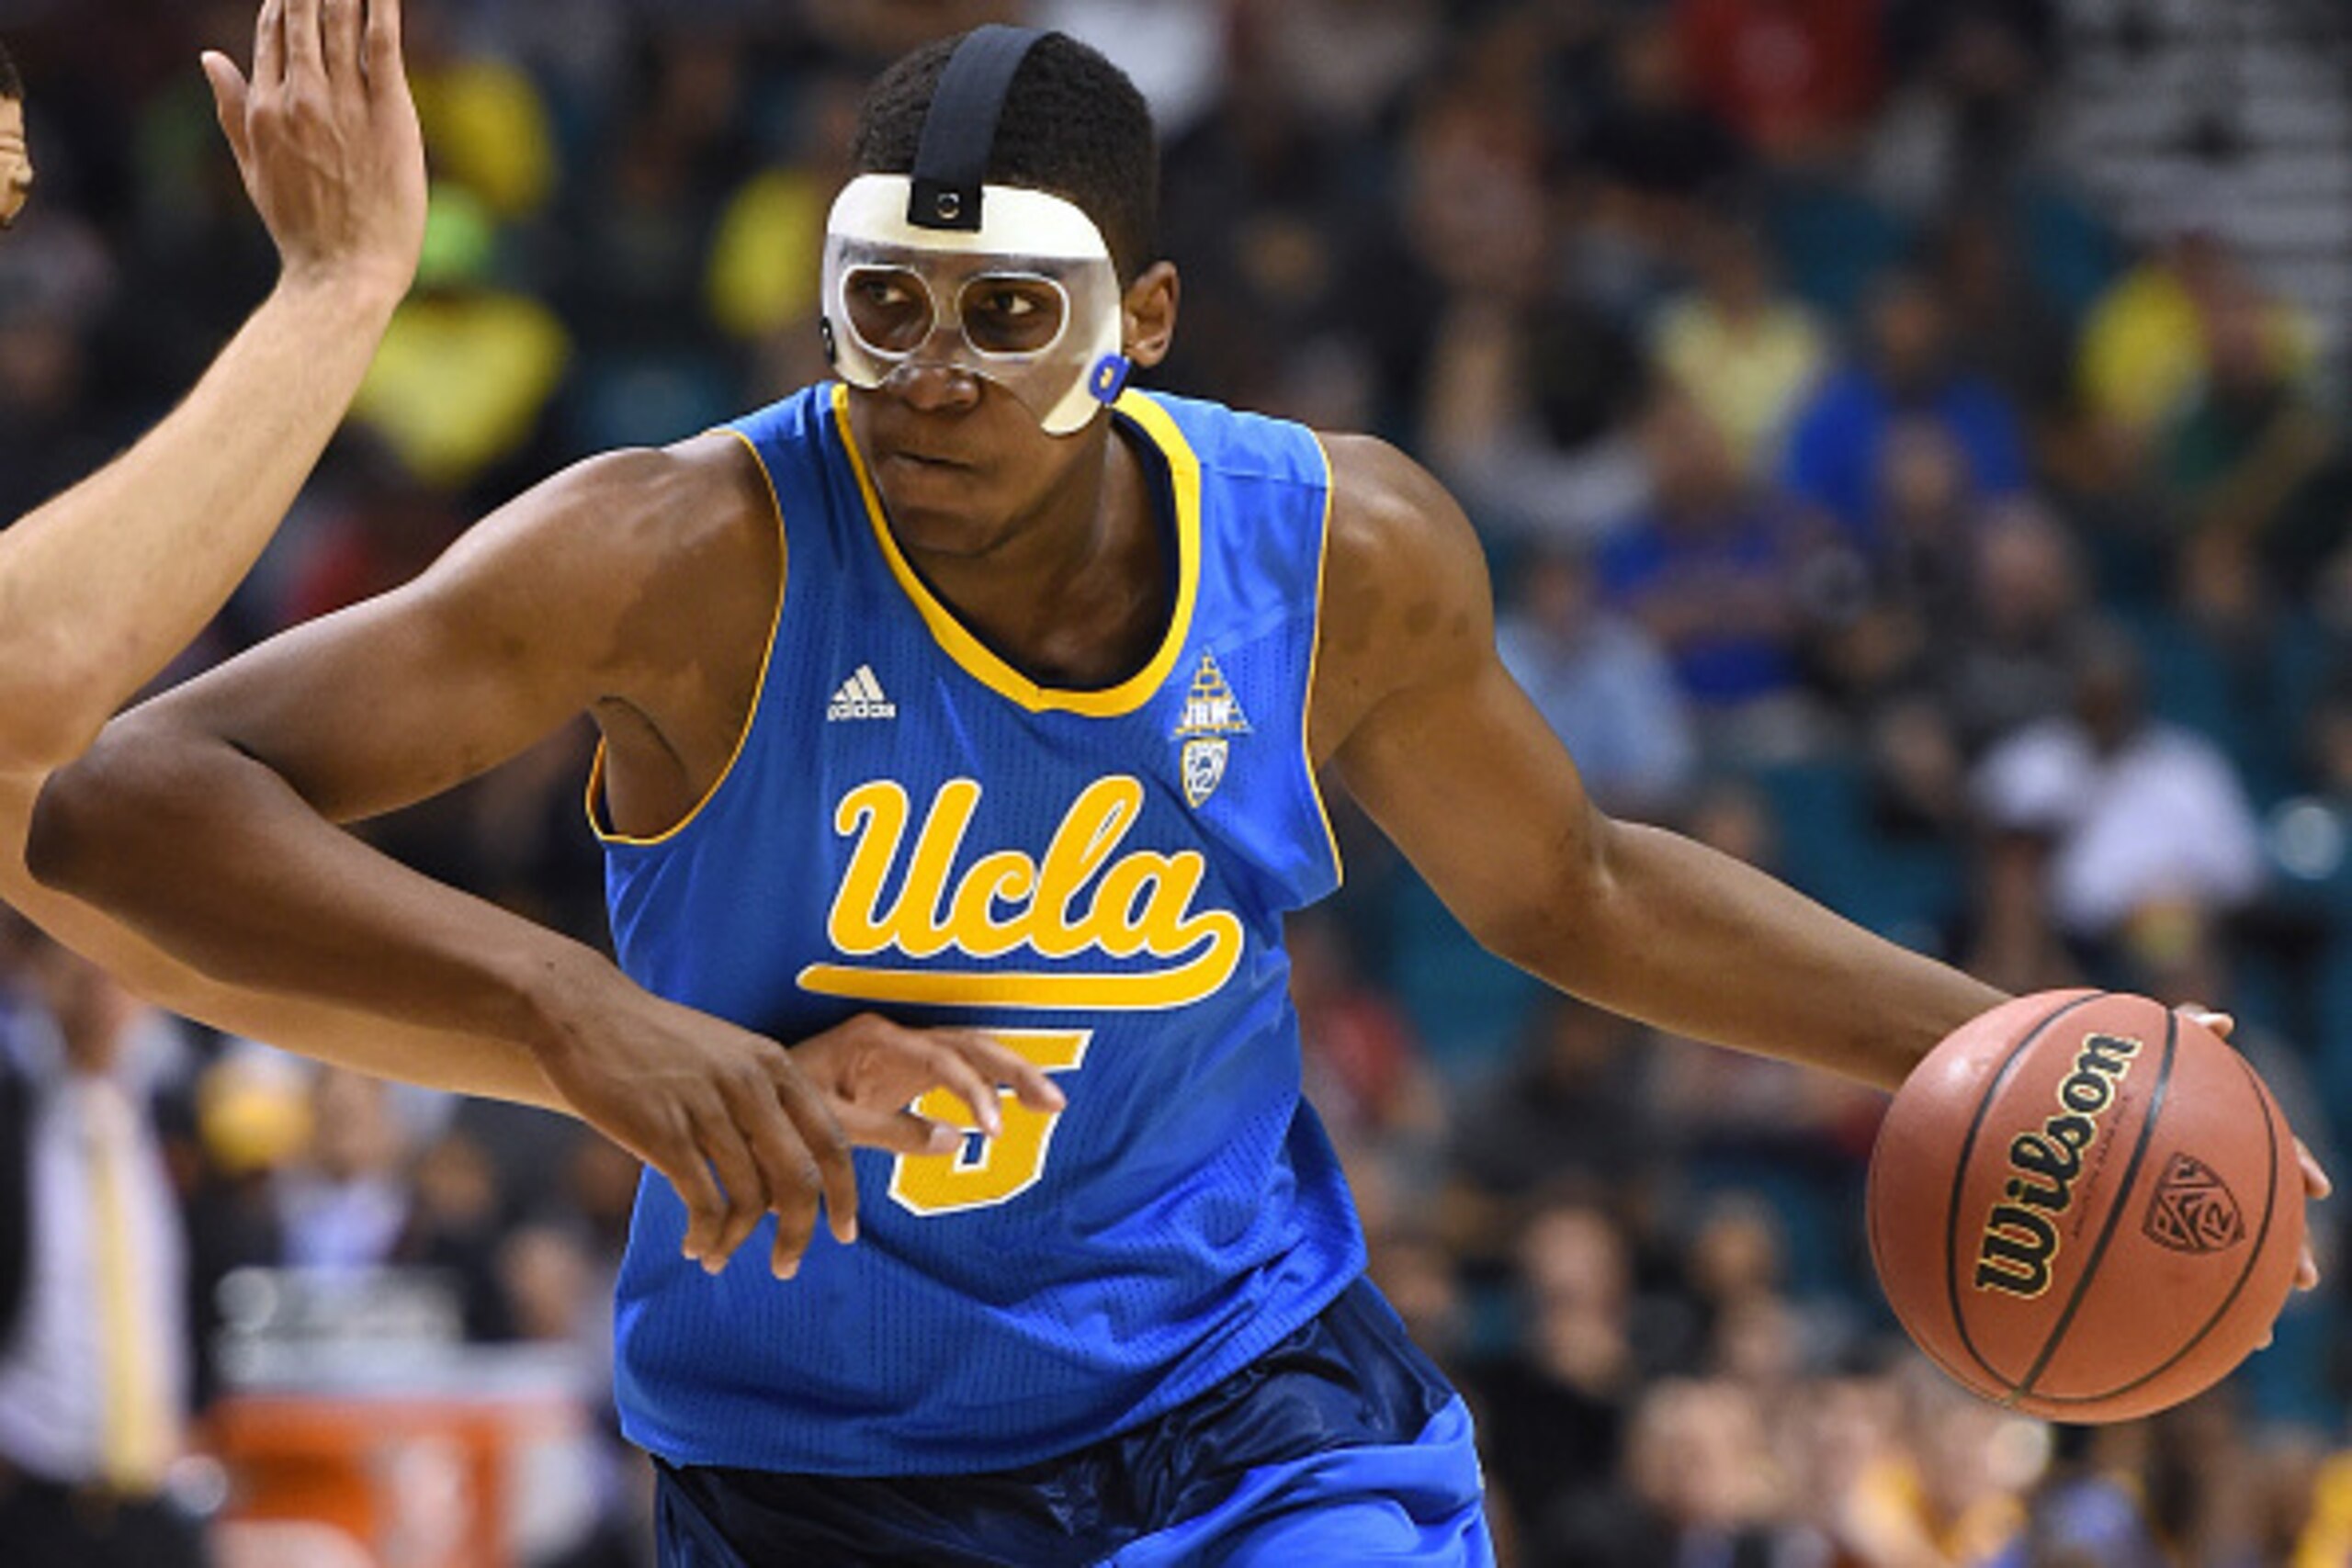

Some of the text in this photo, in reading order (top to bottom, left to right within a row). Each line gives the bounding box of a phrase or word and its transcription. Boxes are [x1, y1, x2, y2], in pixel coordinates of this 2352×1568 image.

[827, 700, 896, 721] adidas
[827, 775, 1244, 960] Ucla
[888, 1029, 1094, 1217] 5
[1974, 1033, 2142, 1299] Wilson
[2201, 1201, 2232, 1241] 12
